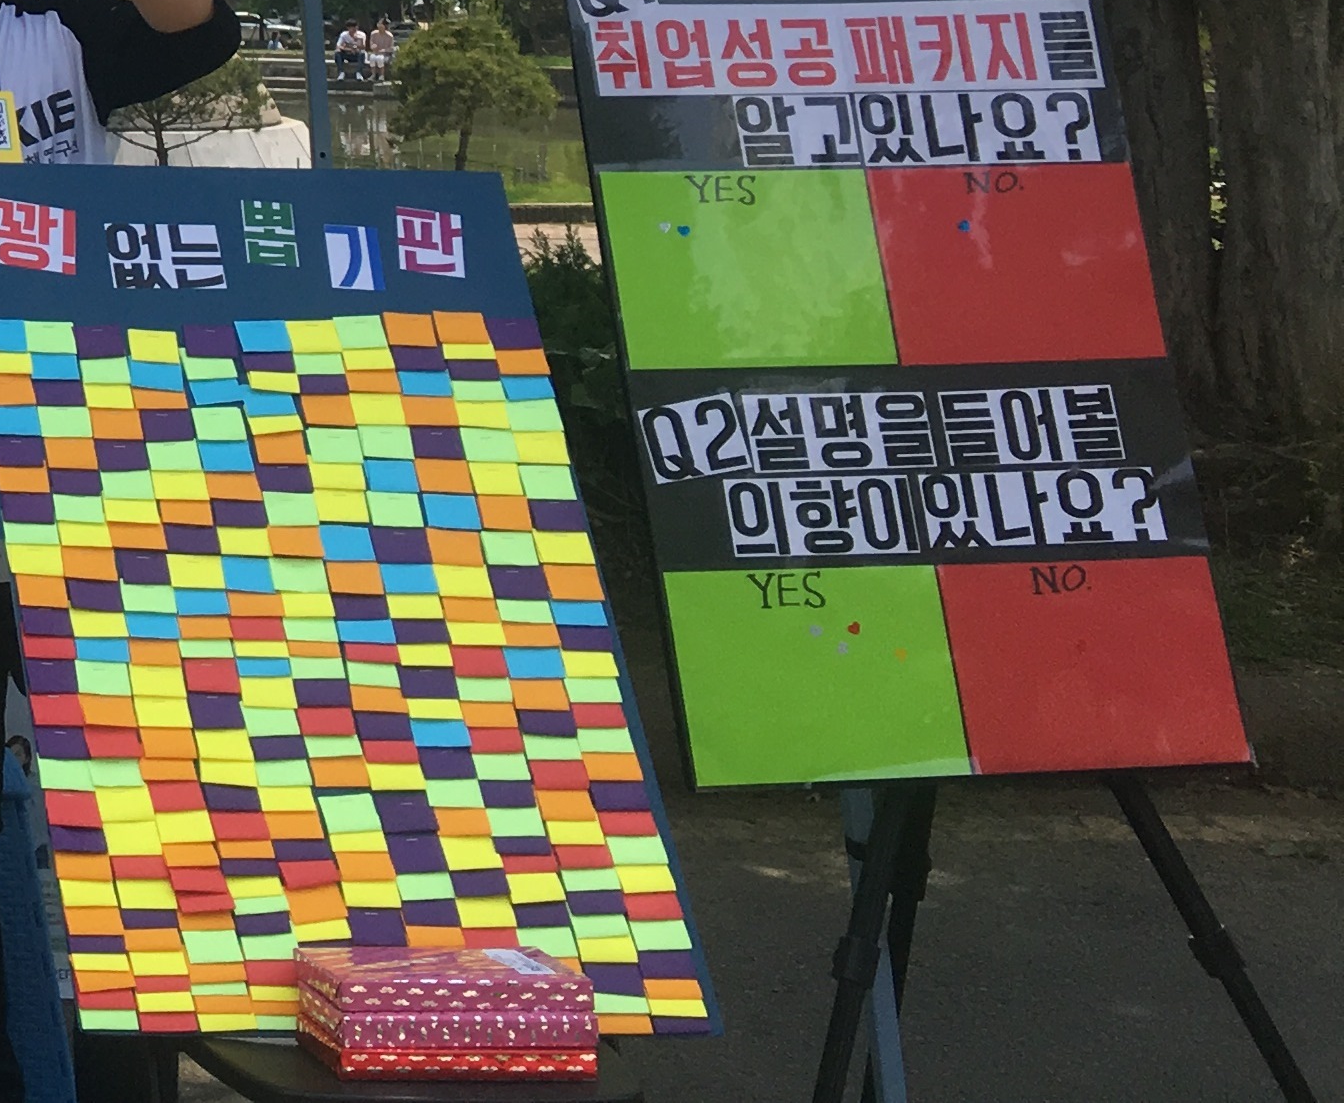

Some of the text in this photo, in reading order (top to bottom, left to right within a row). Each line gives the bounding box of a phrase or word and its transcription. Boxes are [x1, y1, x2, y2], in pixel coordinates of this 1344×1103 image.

[685, 175, 757, 206] YES
[107, 223, 225, 288] 없는
[641, 399, 748, 481] Q2
[748, 572, 826, 610] YES
